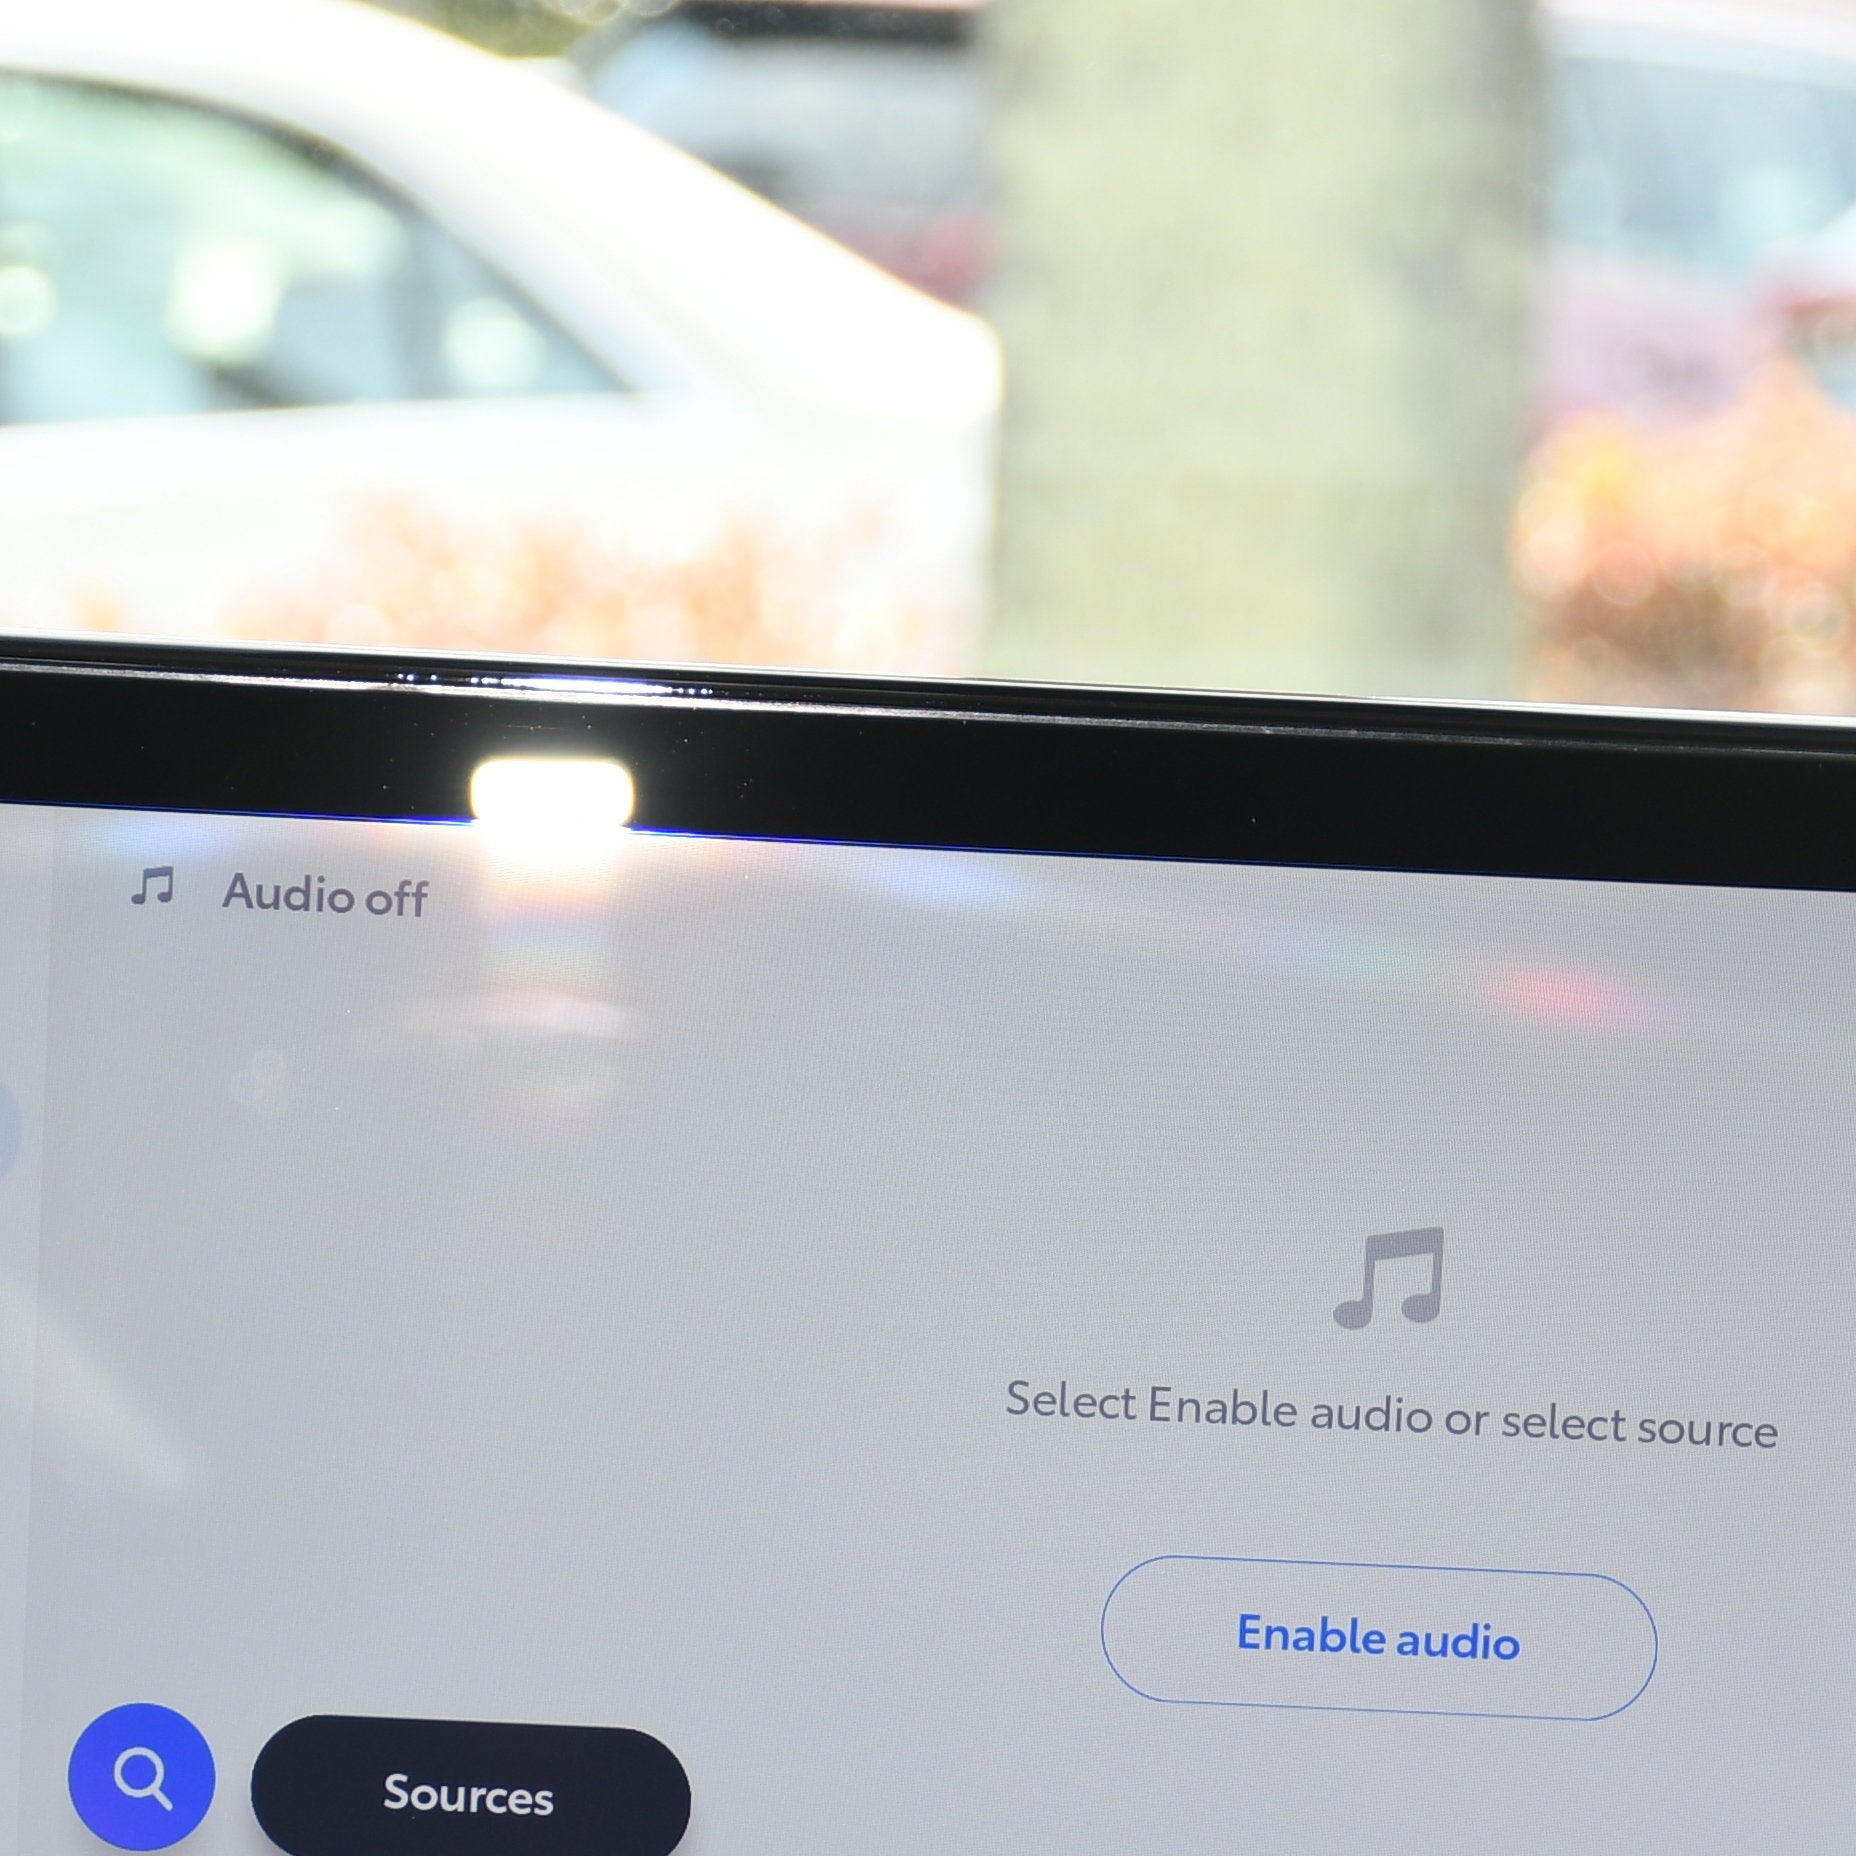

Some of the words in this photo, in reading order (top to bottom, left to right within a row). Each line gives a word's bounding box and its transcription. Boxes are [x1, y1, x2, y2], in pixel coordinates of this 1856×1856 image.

[221, 872, 355, 914] Audio
[365, 879, 430, 918] off
[1006, 1379, 1138, 1421] Select
[1149, 1385, 1298, 1428] Enable
[1310, 1394, 1433, 1434] audio
[1445, 1410, 1490, 1436] or
[1501, 1402, 1627, 1443] select
[1637, 1418, 1779, 1449] source
[1238, 1613, 1387, 1655] Enable
[1396, 1622, 1521, 1661] audio
[383, 1773, 554, 1816] Sources
